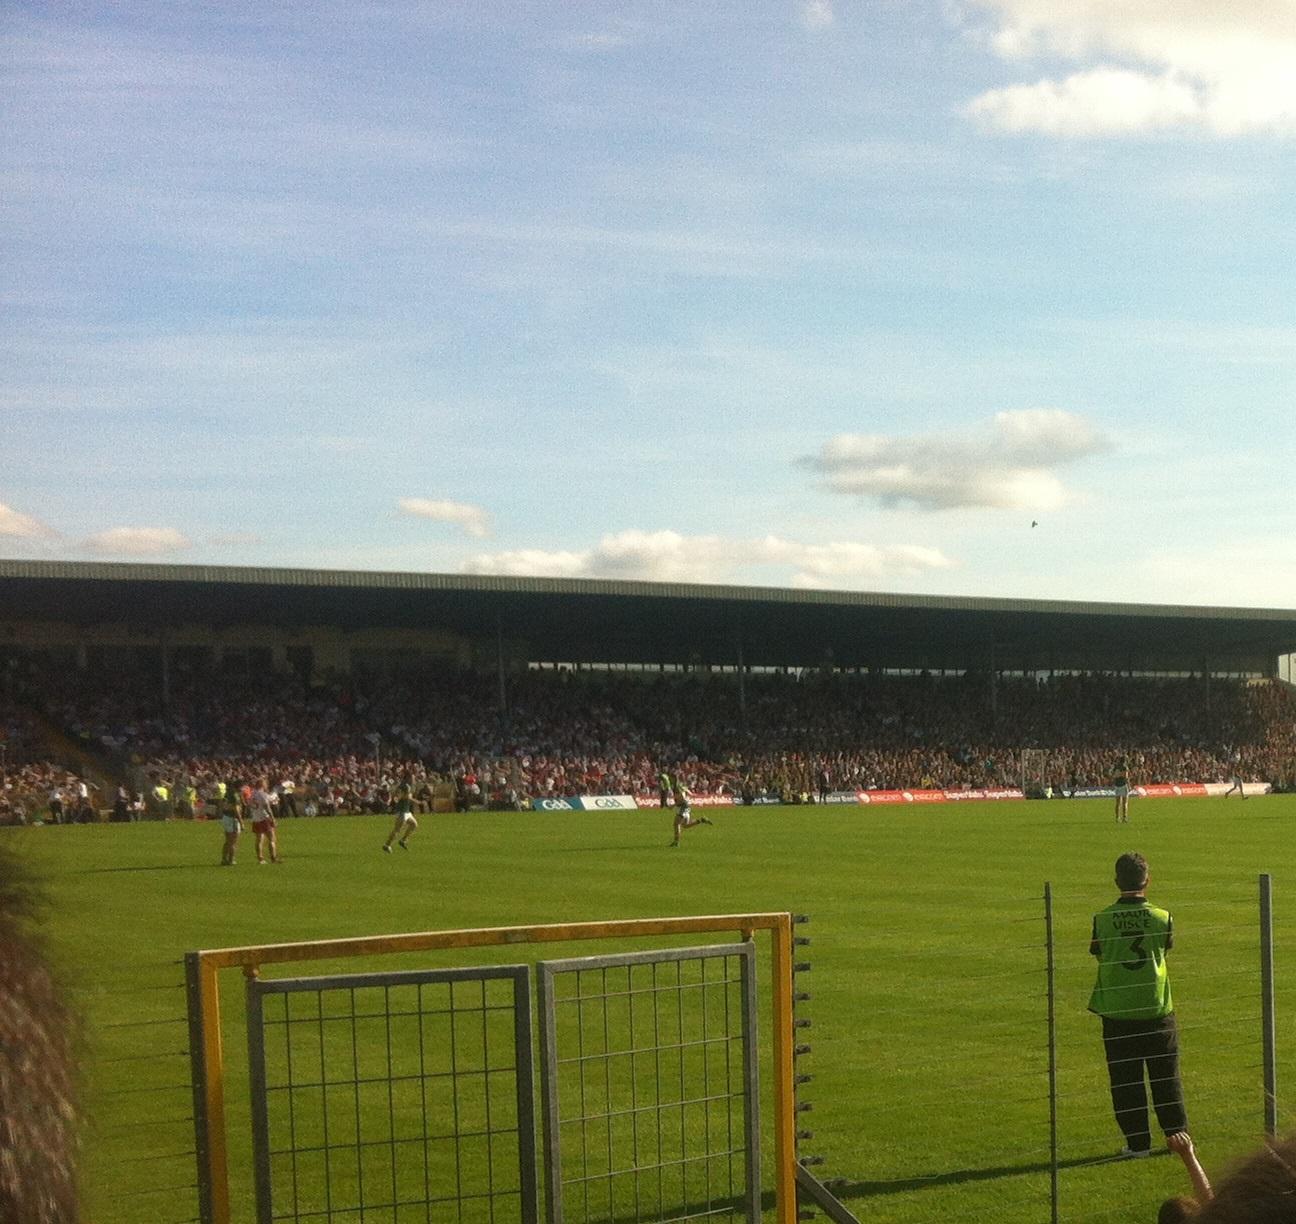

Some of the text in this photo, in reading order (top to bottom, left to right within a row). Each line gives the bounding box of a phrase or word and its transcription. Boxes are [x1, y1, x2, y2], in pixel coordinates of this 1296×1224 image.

[542, 799, 573, 810] GAA
[595, 798, 624, 808] GAA
[1120, 930, 1148, 971] 3
